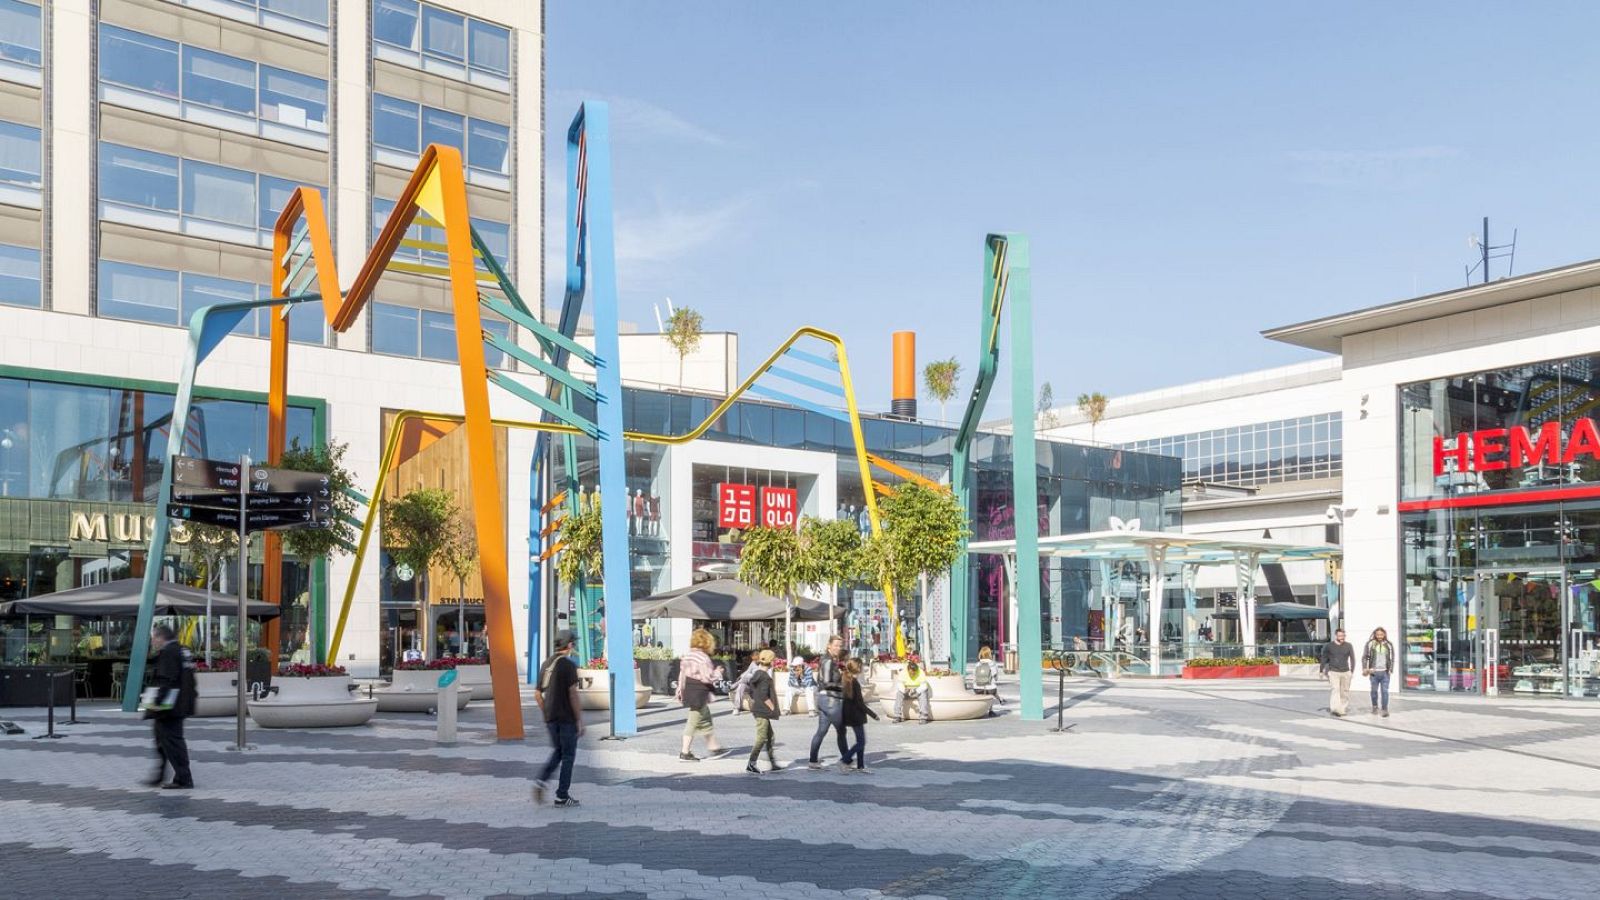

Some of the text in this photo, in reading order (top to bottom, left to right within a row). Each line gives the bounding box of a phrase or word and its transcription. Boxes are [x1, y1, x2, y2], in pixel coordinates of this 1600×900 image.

[1433, 417, 1600, 476] HEMA
[766, 492, 791, 508] UNI
[766, 509, 793, 526] QLO
